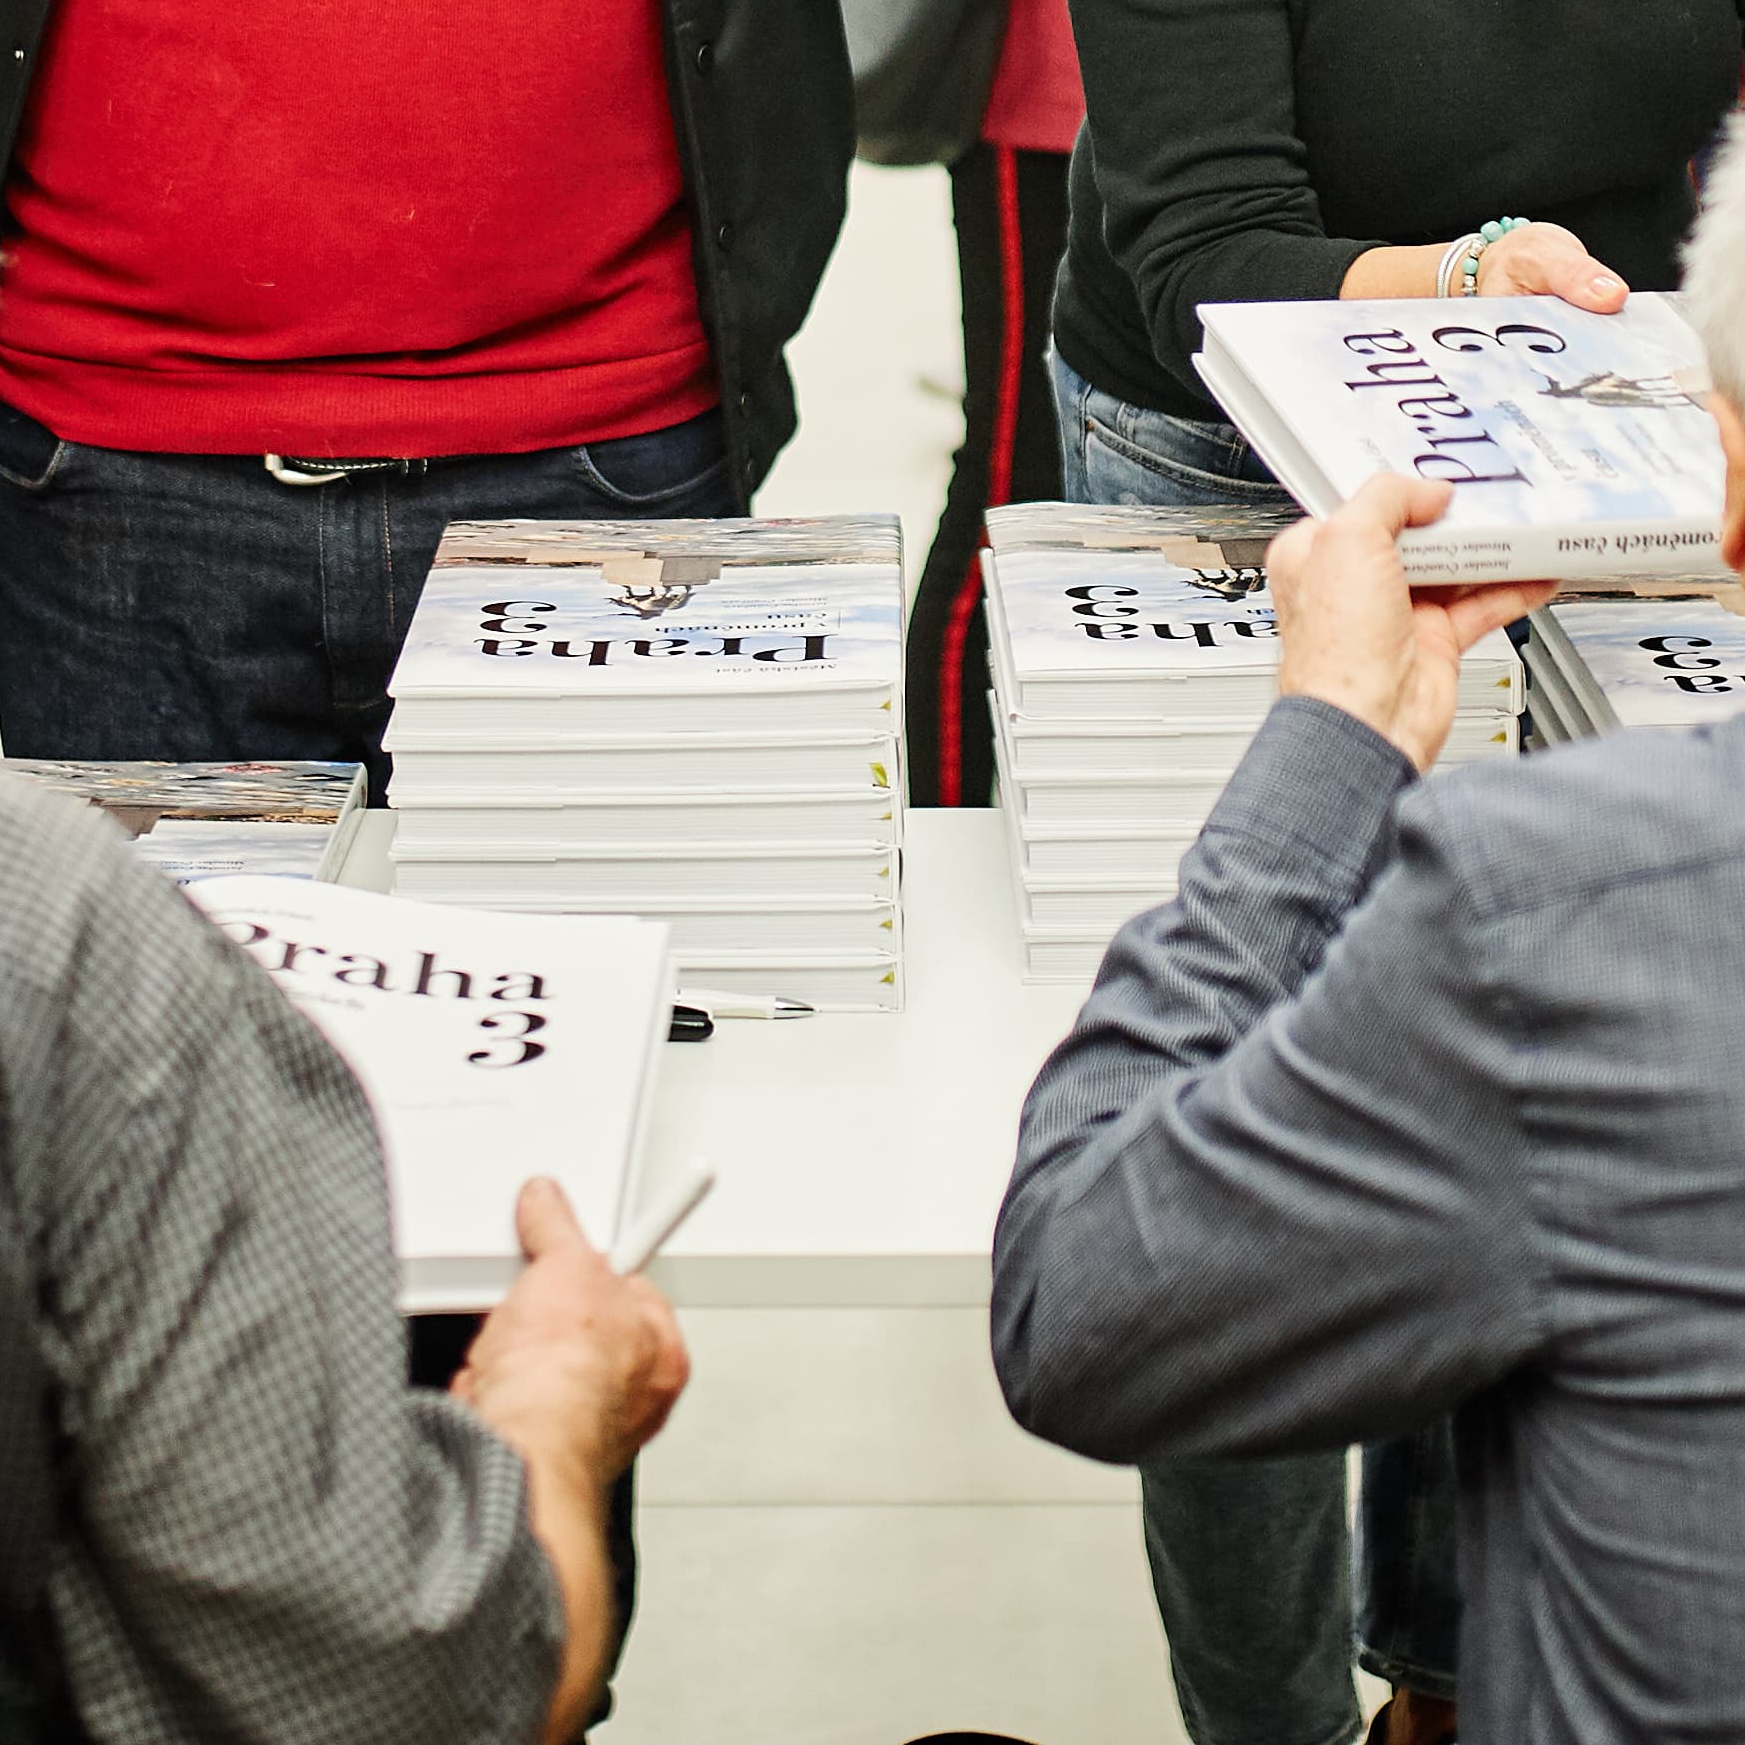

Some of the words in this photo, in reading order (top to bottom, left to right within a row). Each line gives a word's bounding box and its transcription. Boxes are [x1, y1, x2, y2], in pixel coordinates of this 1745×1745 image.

[1431, 324, 1567, 354] 3
[1342, 327, 1535, 490] Praha
[480, 600, 558, 634] 3
[1063, 584, 1141, 619] 3
[472, 634, 839, 667] Praha
[1637, 636, 1722, 670] 3
[466, 1009, 550, 1070] 3
